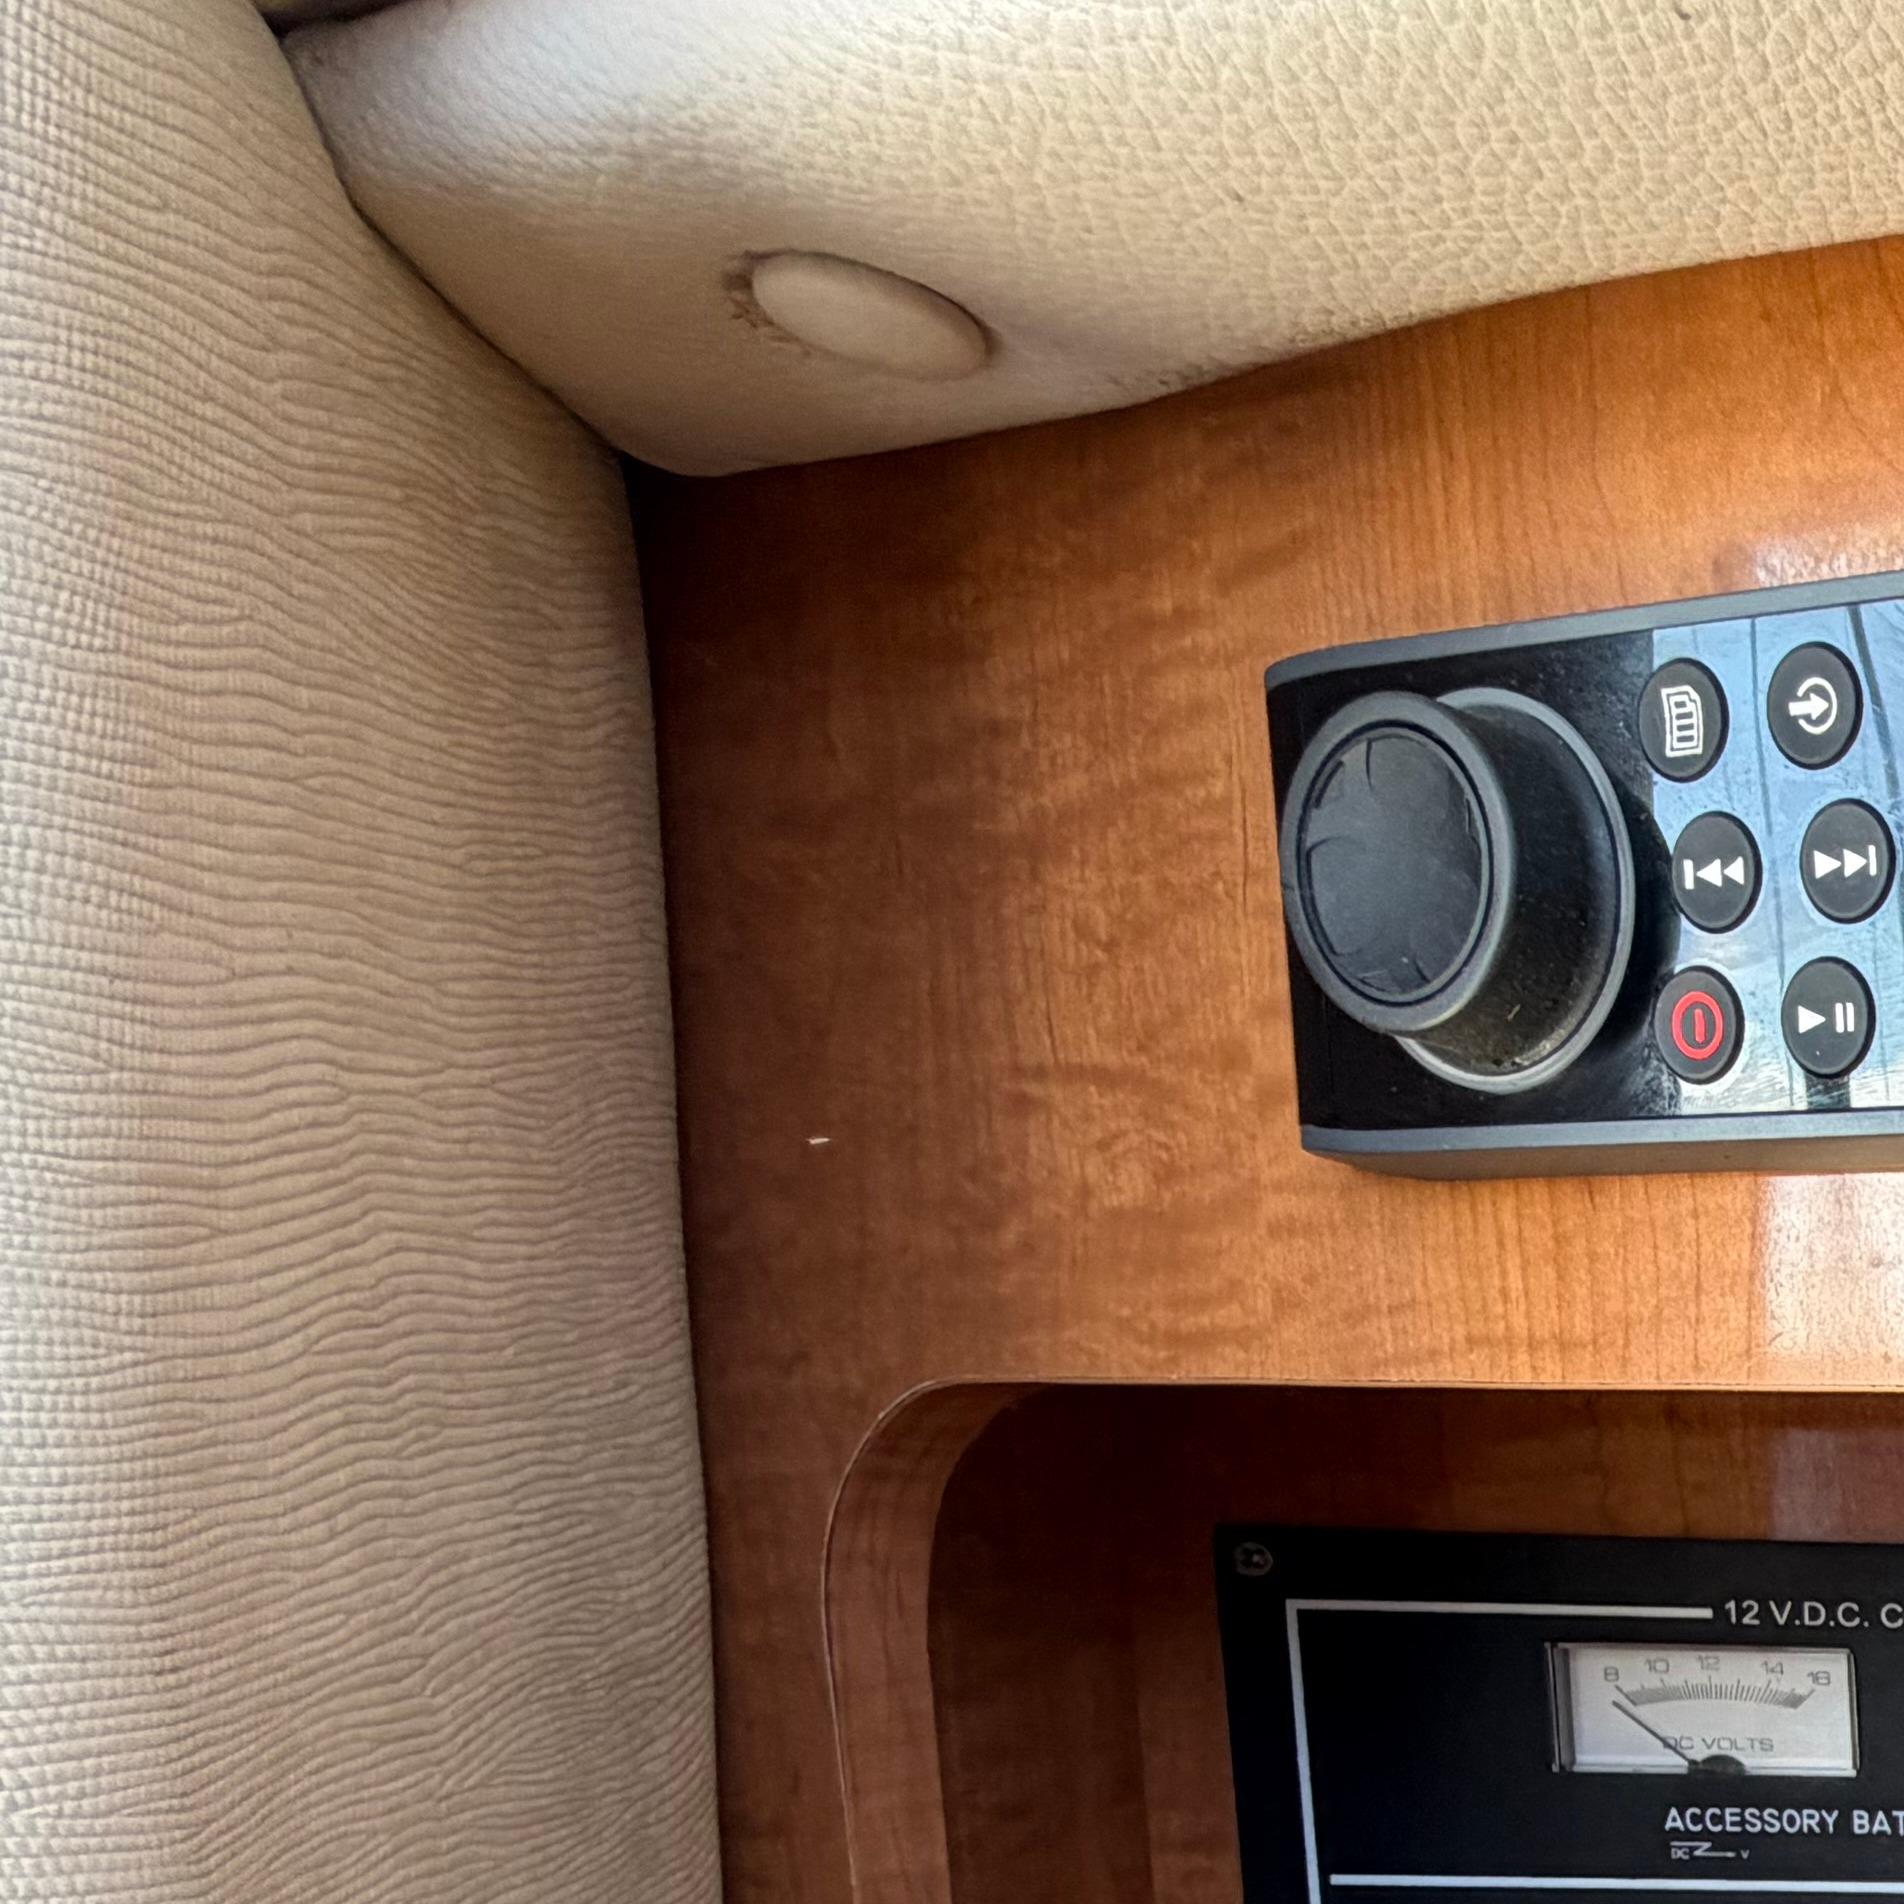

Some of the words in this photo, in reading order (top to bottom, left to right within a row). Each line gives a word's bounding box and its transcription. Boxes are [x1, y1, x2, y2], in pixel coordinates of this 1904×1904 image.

[1724, 1600, 1760, 1625] 12
[1767, 1601, 1870, 1628] V.D.C.
[1603, 1666, 1620, 1683] 8
[1643, 1658, 1670, 1675] 10
[1698, 1655, 1721, 1672] 12
[1761, 1660, 1785, 1676] 14
[1701, 1736, 1775, 1752] VOLTS
[1664, 1806, 1839, 1836] ACCESSORY
